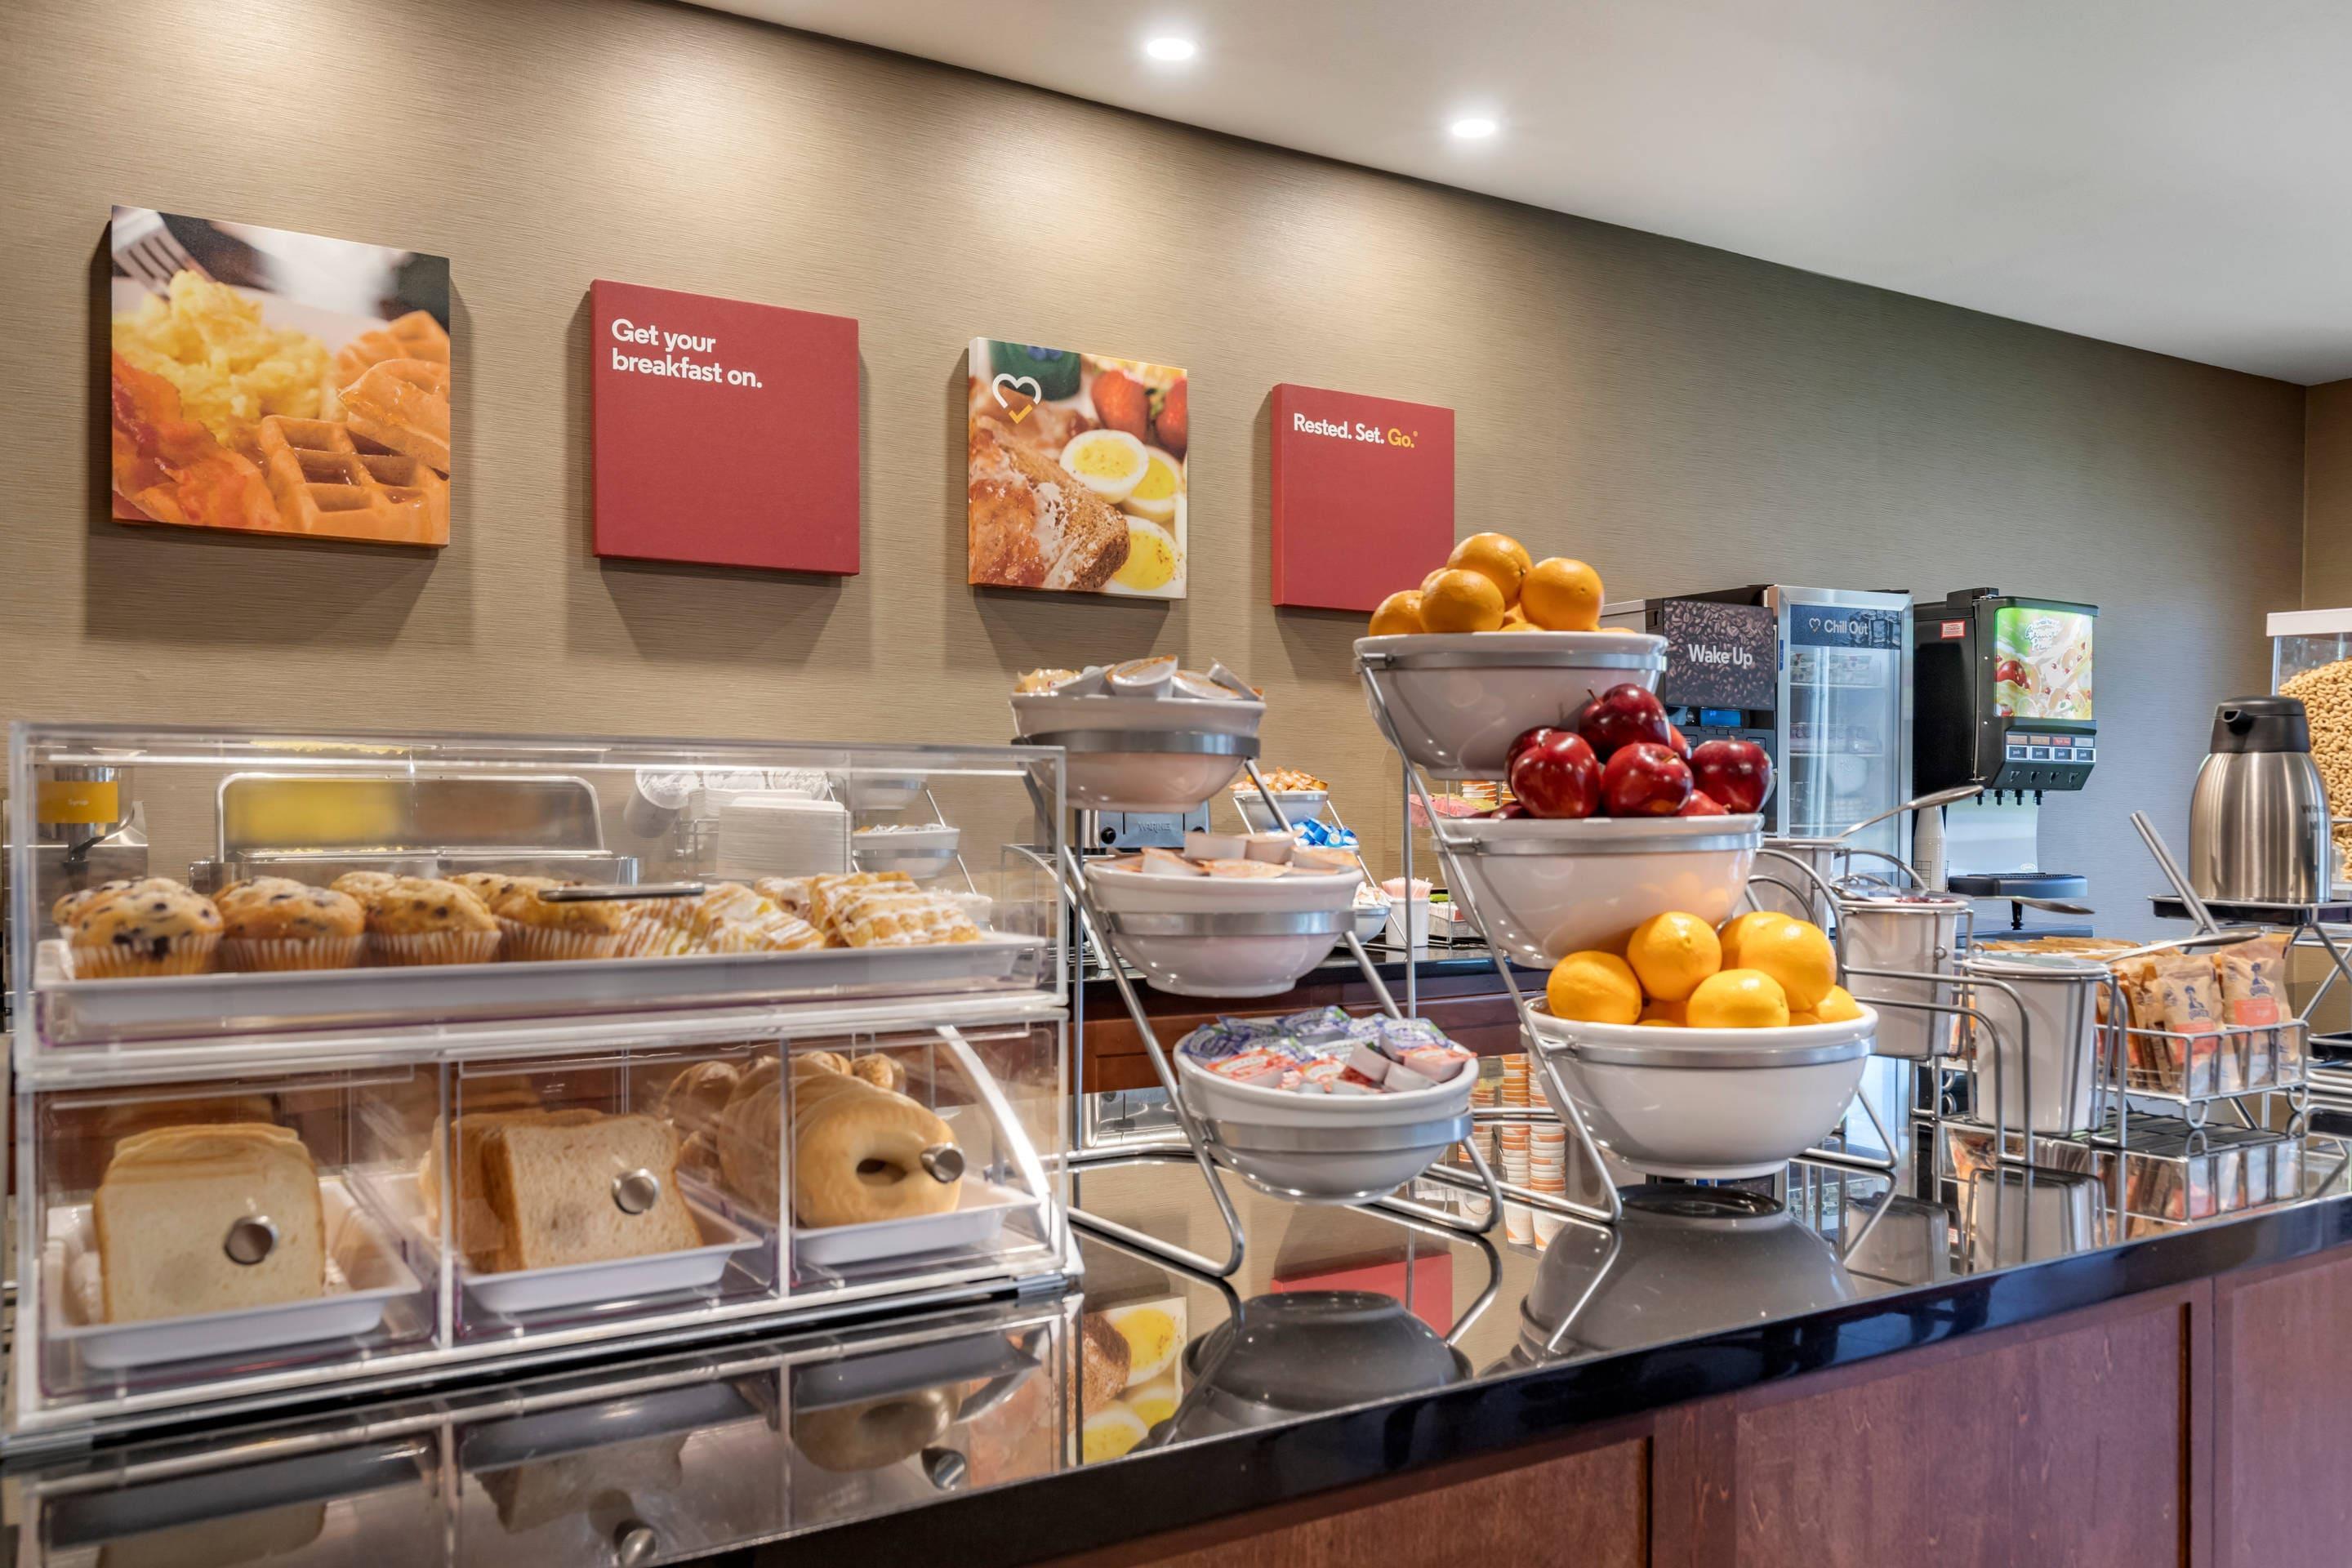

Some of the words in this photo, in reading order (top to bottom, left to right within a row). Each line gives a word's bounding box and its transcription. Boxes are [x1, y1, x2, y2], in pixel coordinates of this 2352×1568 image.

[612, 318, 659, 346] Get
[663, 331, 716, 353] your
[612, 347, 723, 383] breakfast
[727, 368, 763, 389] on.
[1294, 412, 1352, 439] Rested.
[1355, 422, 1385, 444] Set.
[1824, 619, 1847, 634] Chill
[1849, 620, 1869, 635] Out
[1687, 643, 1731, 665] Wake
[1732, 646, 1753, 670] Up
